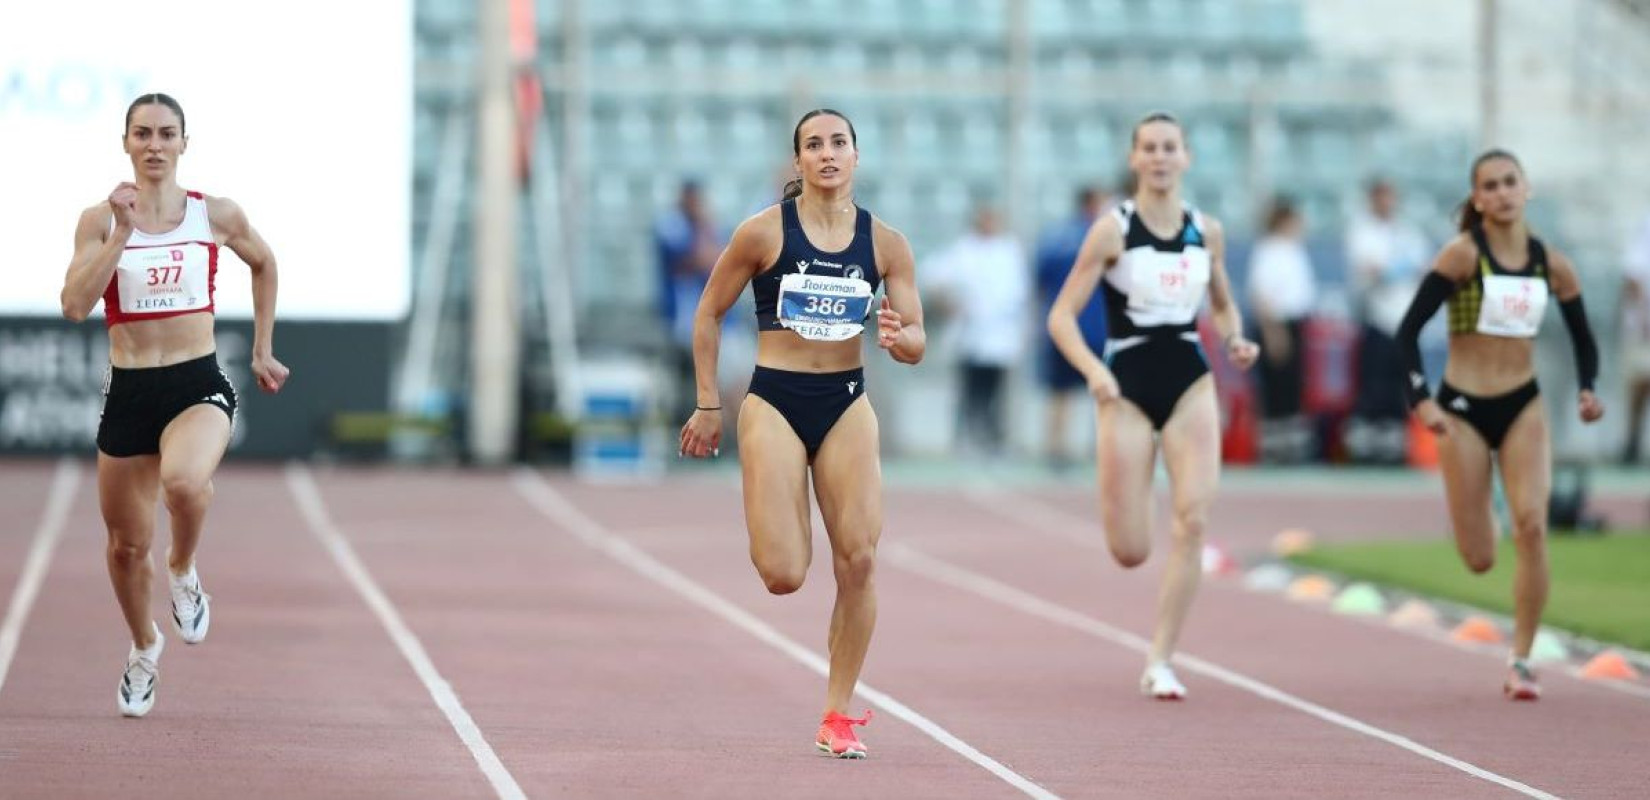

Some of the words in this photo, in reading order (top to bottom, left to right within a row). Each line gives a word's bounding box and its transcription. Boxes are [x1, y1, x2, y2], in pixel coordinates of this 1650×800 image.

[147, 266, 182, 286] 377
[802, 280, 857, 293] Stoiximan
[136, 298, 176, 309] ΣΕΓΑΣ
[804, 296, 847, 315] 386
